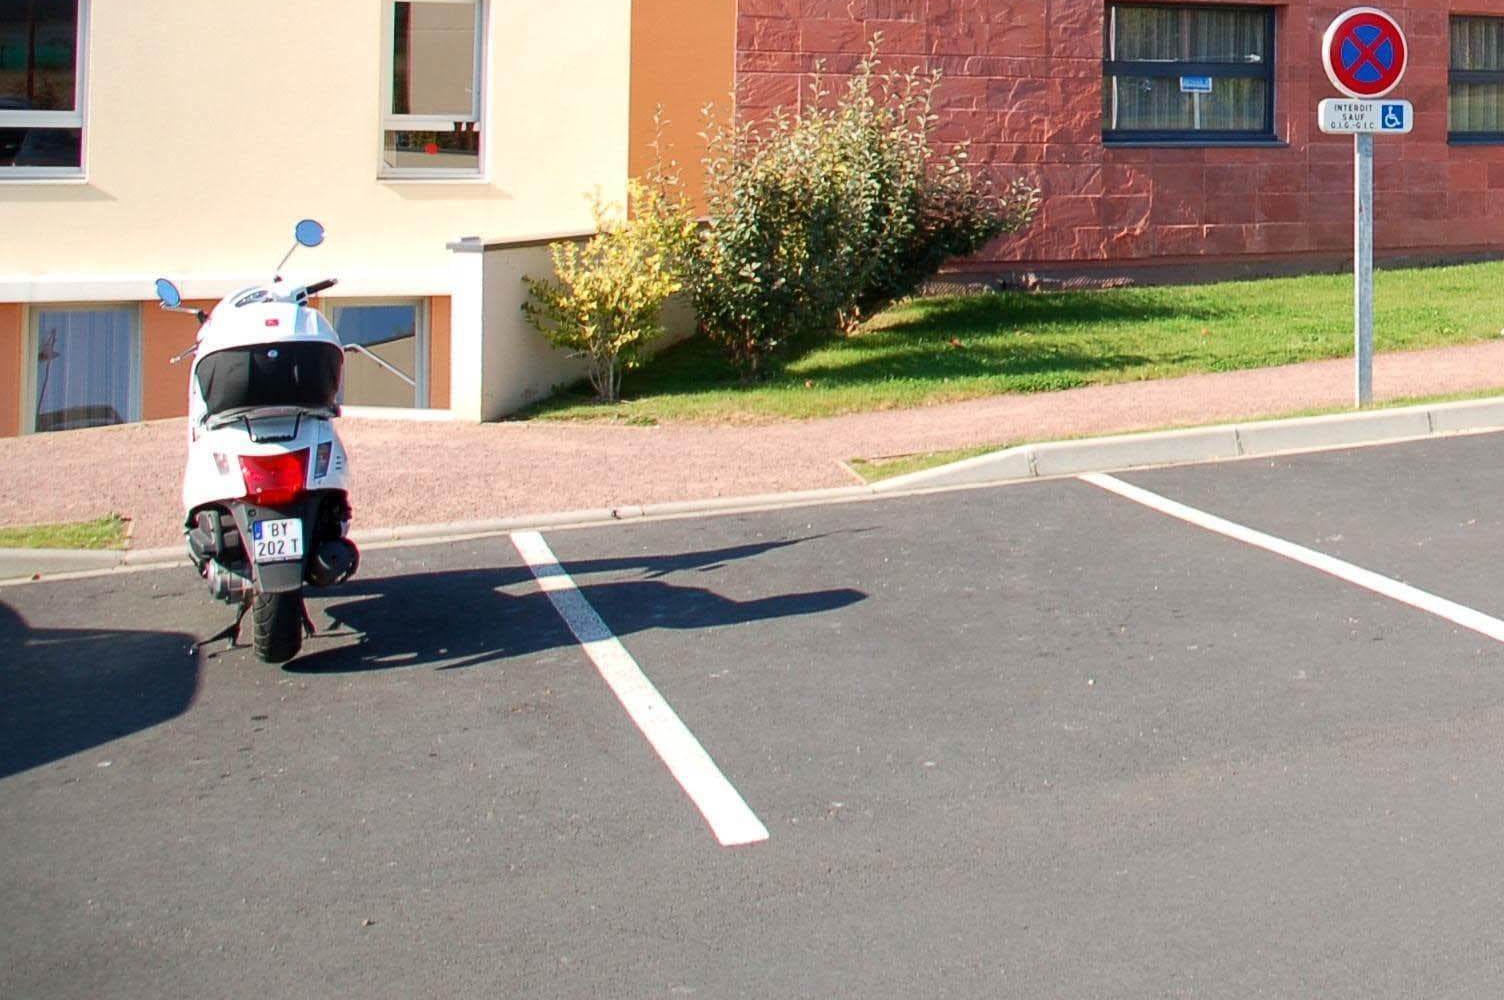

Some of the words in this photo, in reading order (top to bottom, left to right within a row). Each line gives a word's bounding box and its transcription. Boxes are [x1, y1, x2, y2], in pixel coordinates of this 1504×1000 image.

[1334, 104, 1372, 112] INTERDIT
[1342, 113, 1365, 121] SAUF
[271, 522, 287, 537] BY
[258, 540, 285, 556] 202
[291, 538, 299, 553] T
